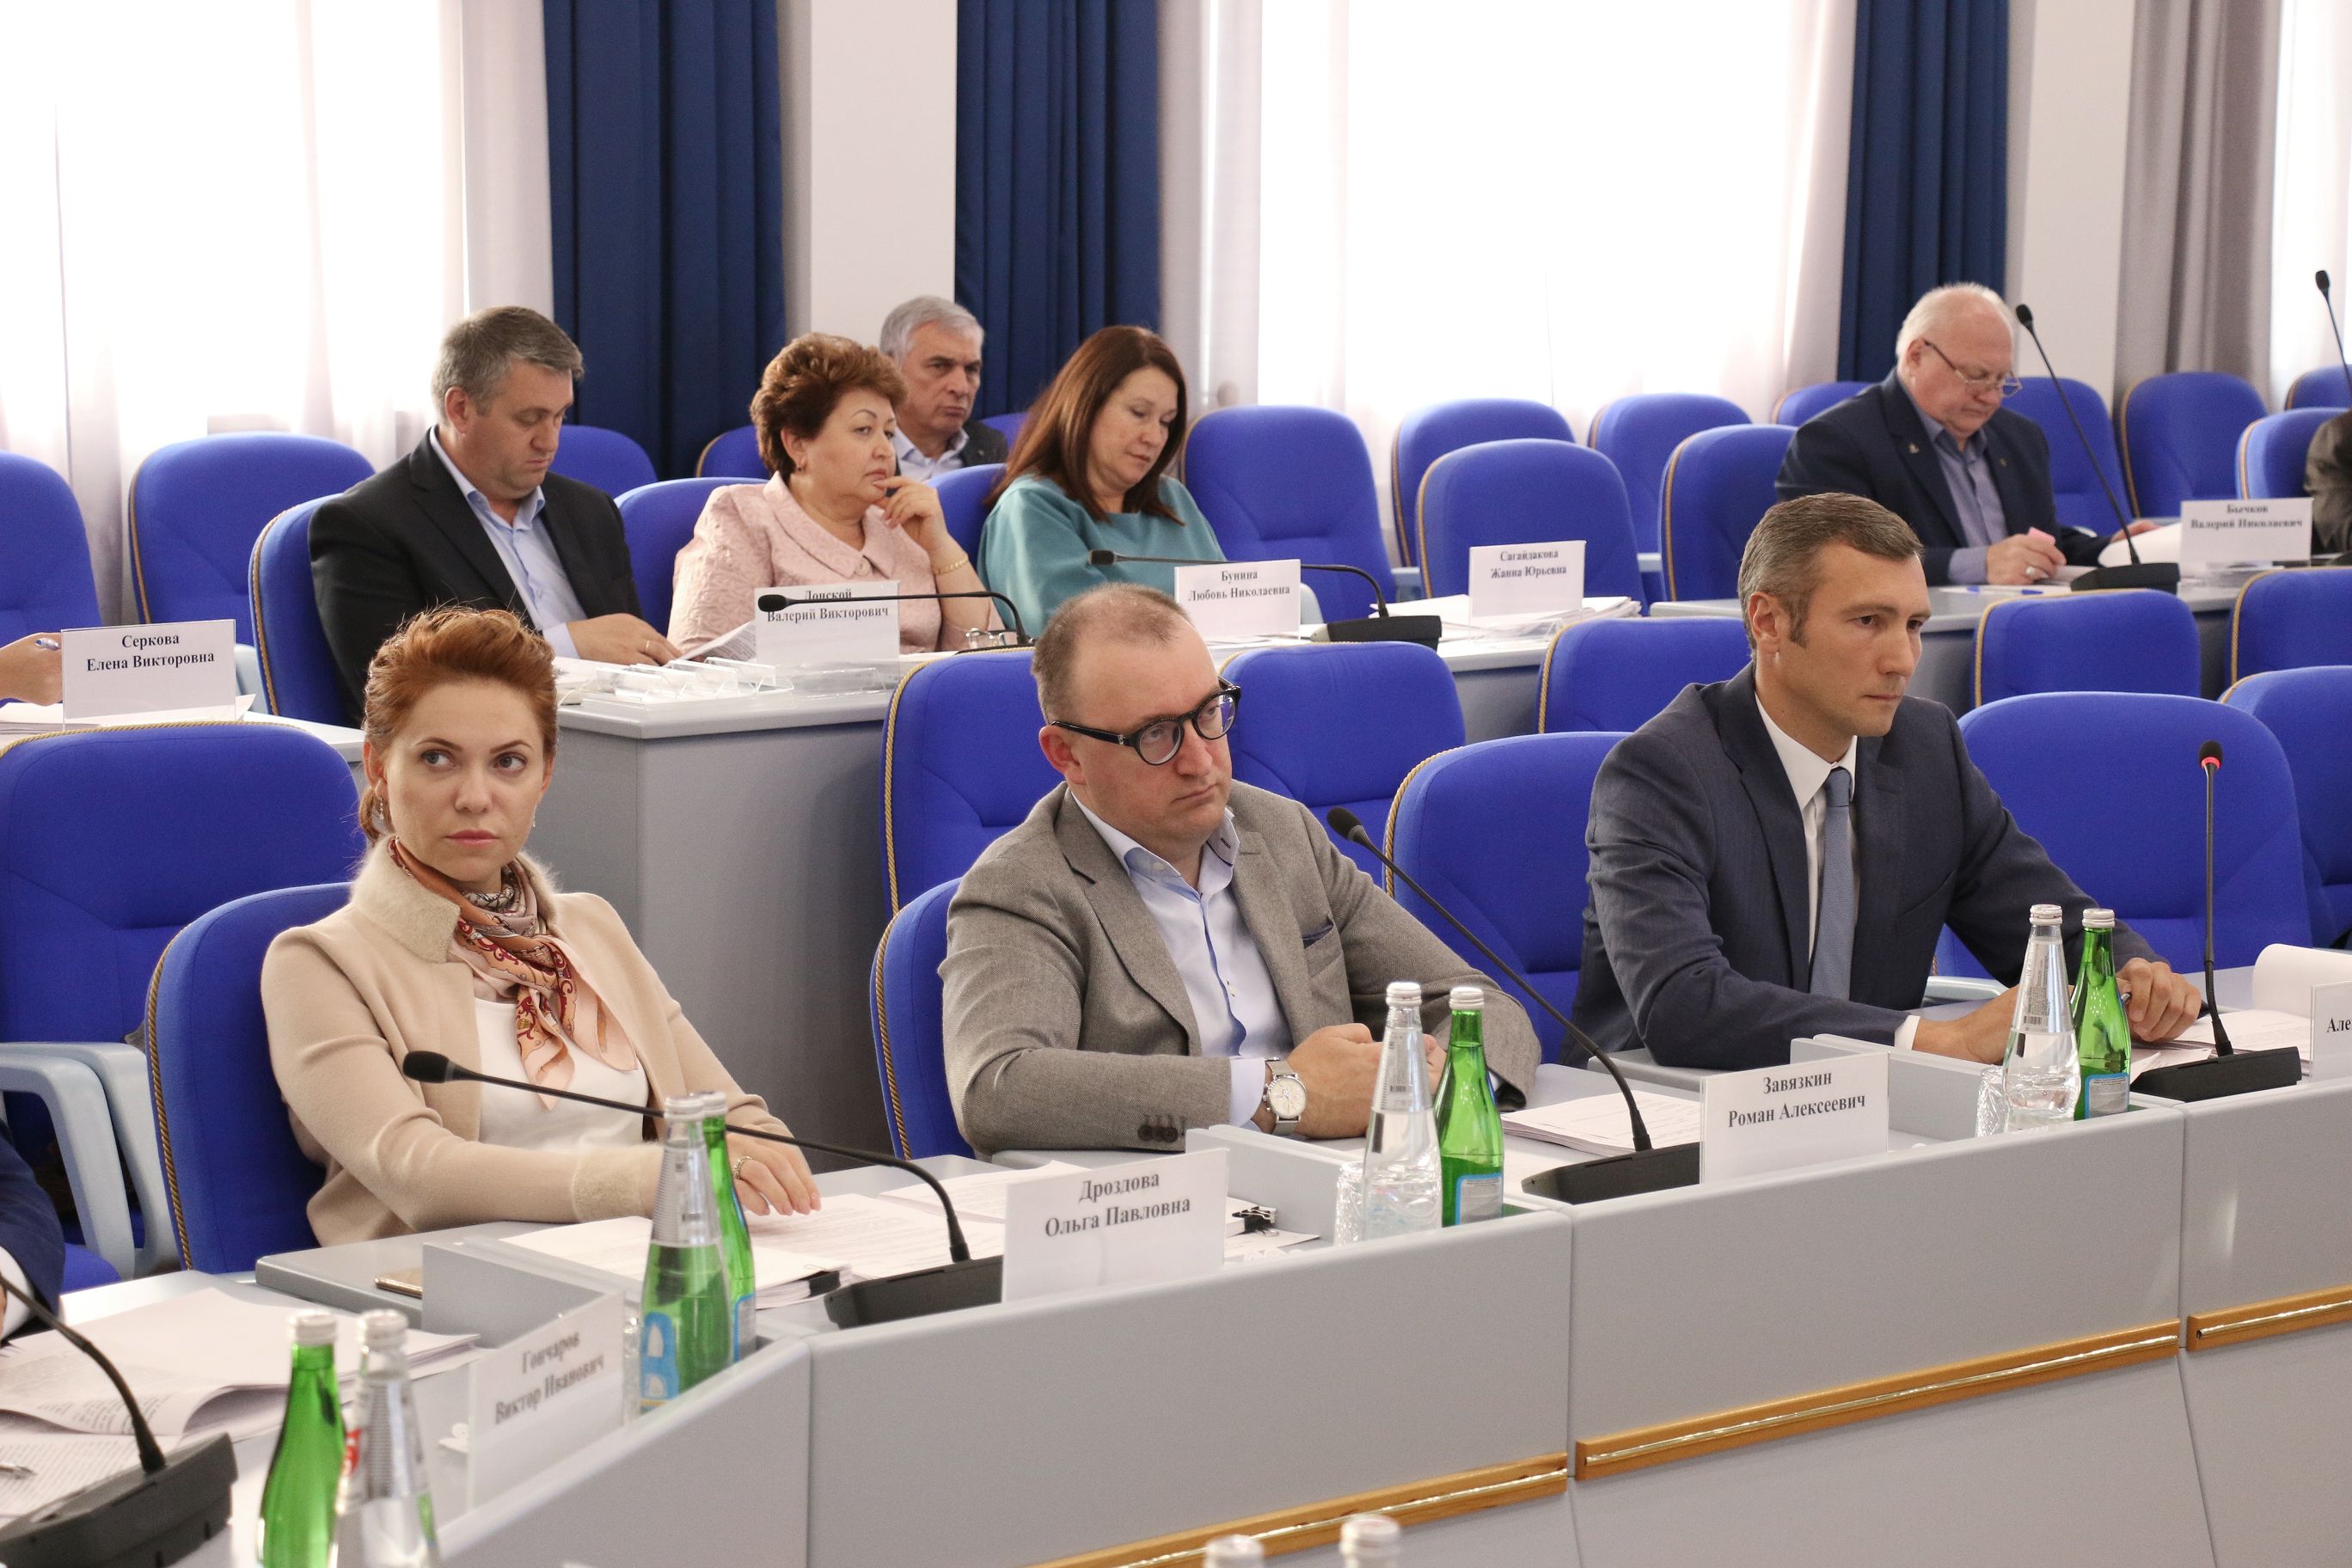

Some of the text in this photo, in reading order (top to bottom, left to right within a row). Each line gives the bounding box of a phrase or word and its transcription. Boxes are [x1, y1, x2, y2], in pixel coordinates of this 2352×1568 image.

[1221, 570, 1258, 584] Бунина
[1490, 566, 1567, 579] Жанна Юрьевна
[1188, 585, 1290, 602] Любовь Николаевна
[767, 606, 889, 624] Валерий Викторович
[121, 634, 180, 651] Серкова
[87, 652, 214, 672] Елена Викторовна
[2326, 1017, 2352, 1033] Але
[1762, 1072, 1832, 1094] Завязкин
[1728, 1094, 1865, 1128] Роман Алексеевич
[1079, 1173, 1160, 1204] Дроздова
[1044, 1197, 1191, 1238] Ольга Павловна
